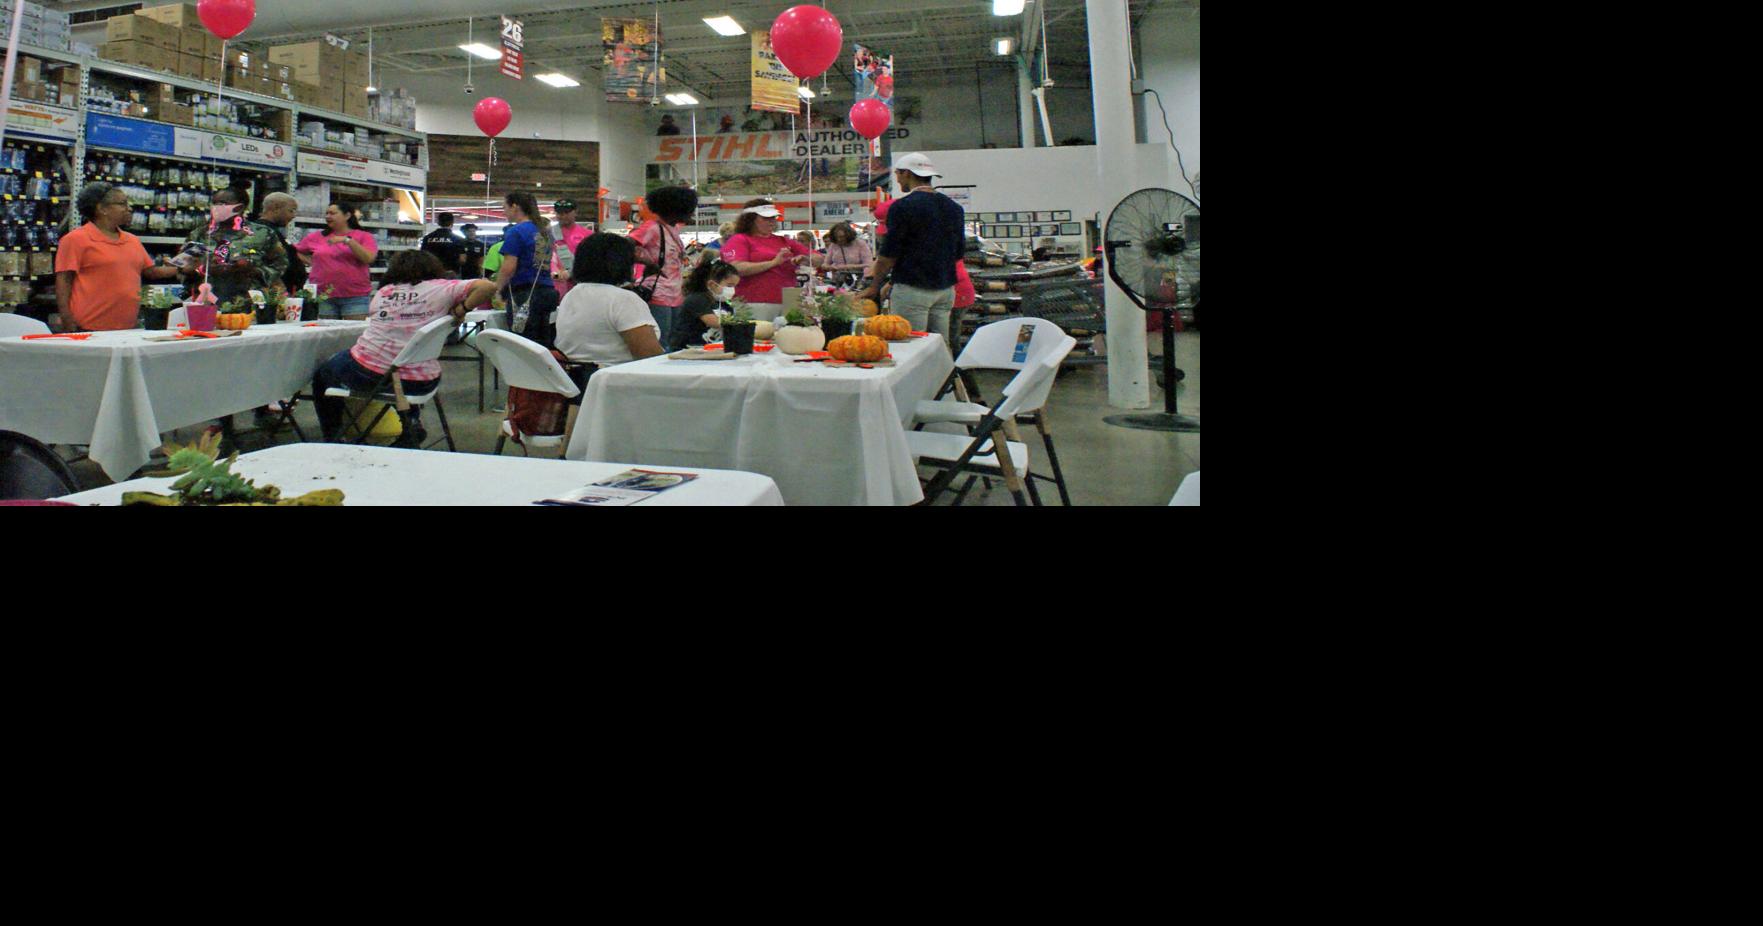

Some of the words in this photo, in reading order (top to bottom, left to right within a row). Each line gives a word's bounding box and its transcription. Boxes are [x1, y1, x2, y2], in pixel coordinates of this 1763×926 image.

[502, 18, 521, 43] 26
[655, 131, 785, 161] STIHL
[795, 127, 910, 145] AUTHOED
[796, 143, 866, 158] DEALER
